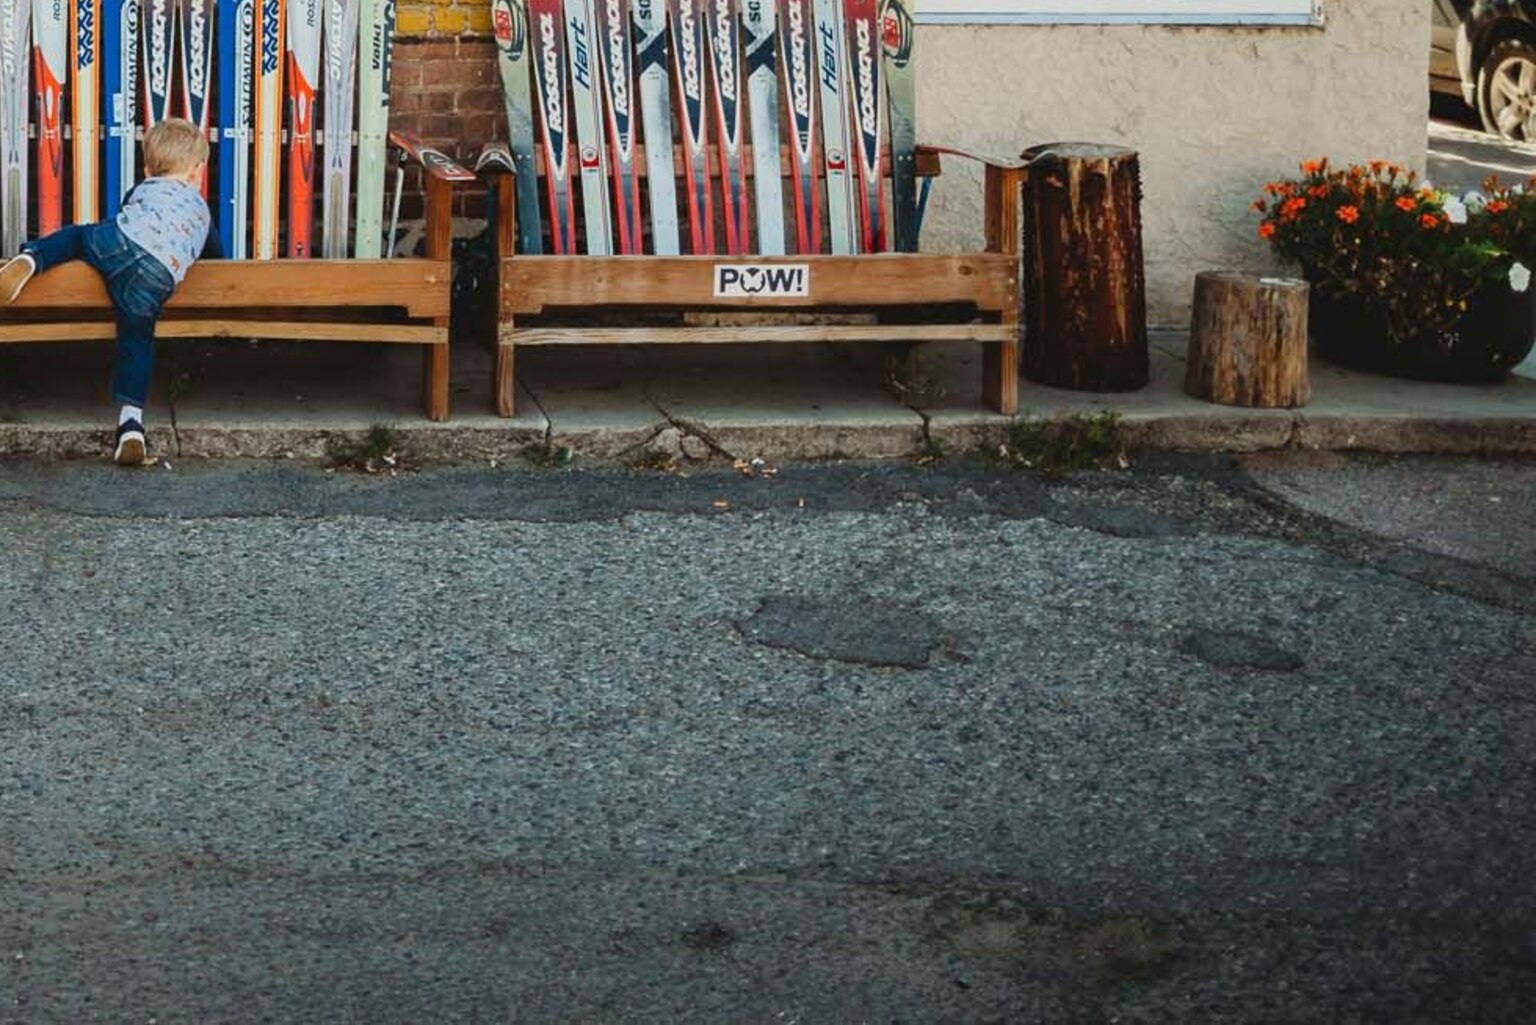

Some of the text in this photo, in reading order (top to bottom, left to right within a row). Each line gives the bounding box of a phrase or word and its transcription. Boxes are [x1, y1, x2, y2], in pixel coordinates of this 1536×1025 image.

[539, 11, 563, 134] ROSSIGNOL
[570, 16, 589, 90] Hart
[819, 21, 838, 94] Hart
[857, 17, 877, 136] ROSSIGNOL
[720, 267, 803, 293] POW!
